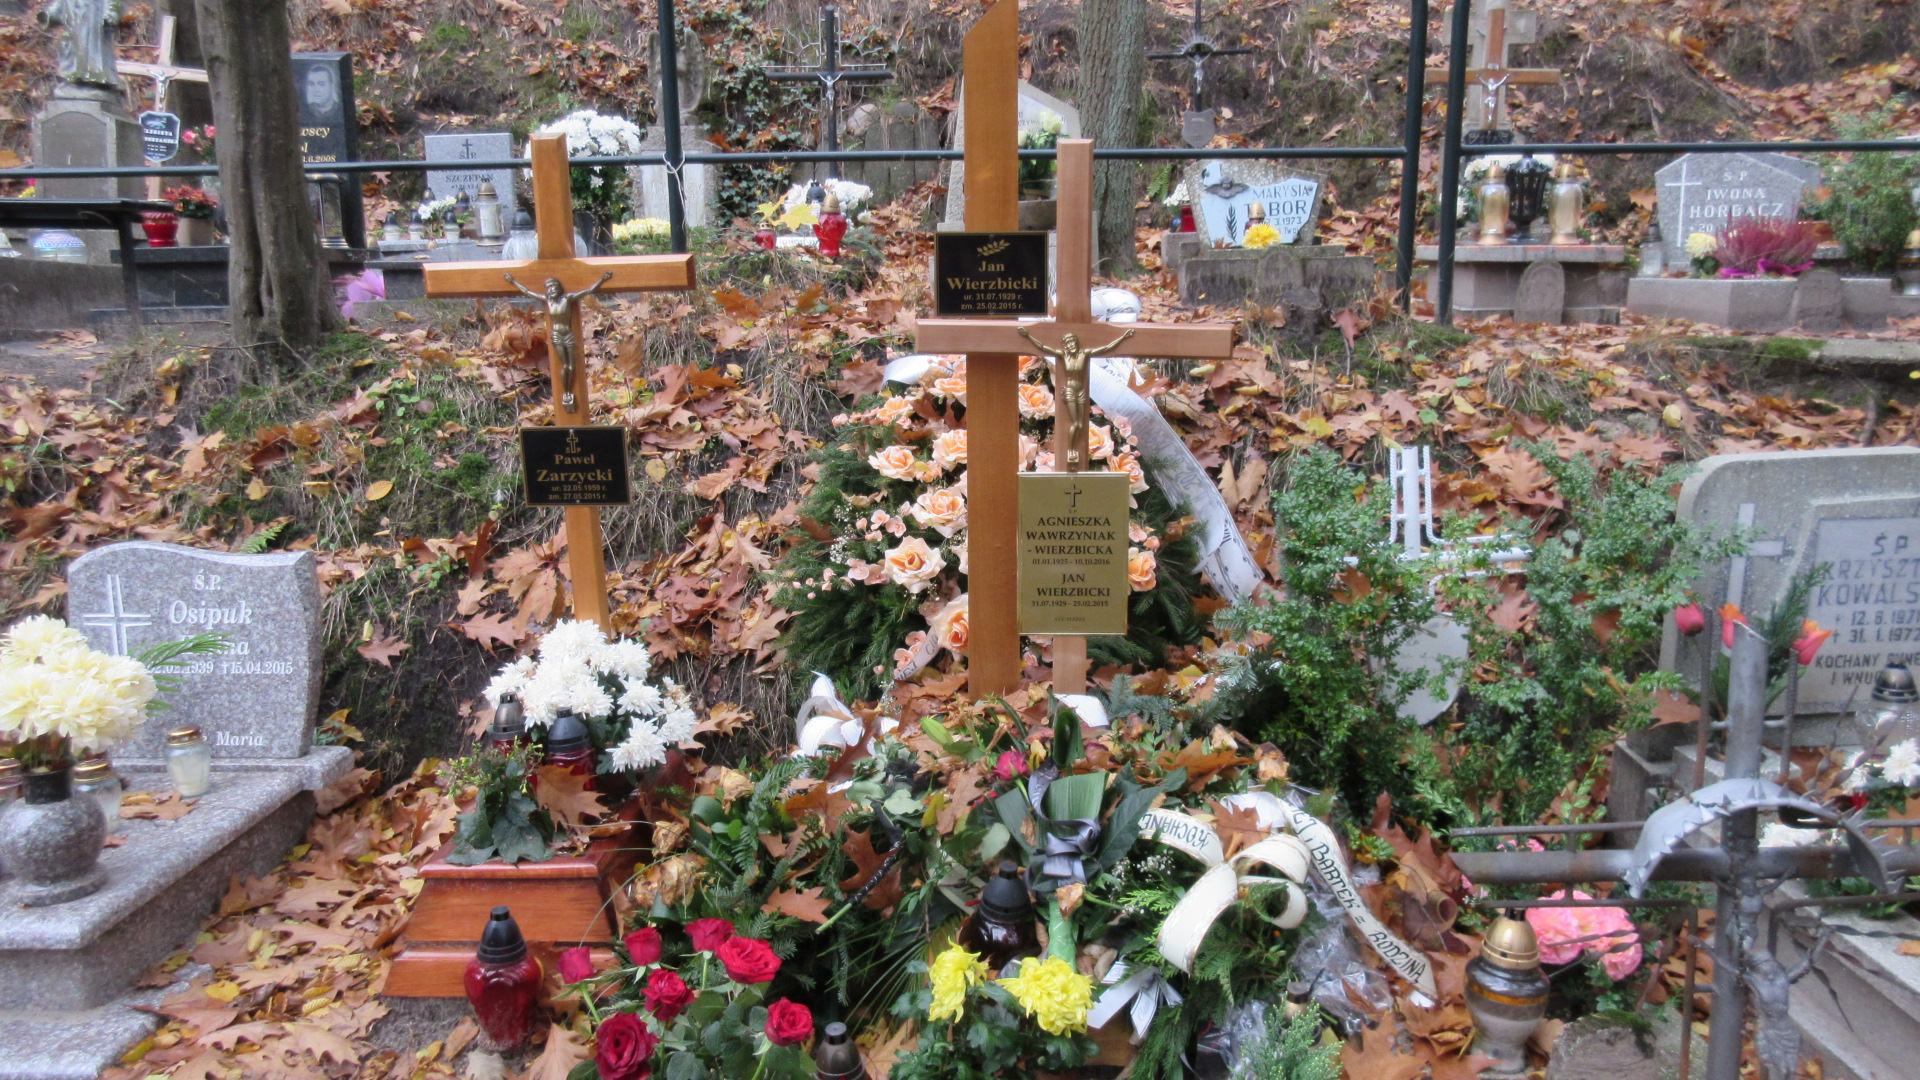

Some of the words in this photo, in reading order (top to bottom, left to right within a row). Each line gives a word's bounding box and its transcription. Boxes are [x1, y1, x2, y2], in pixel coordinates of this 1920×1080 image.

[1252, 184, 1309, 200] MARYSIA
[1706, 187, 1767, 200] IWONA
[1244, 200, 1307, 219] TBOR
[978, 260, 1005, 272] Jan
[946, 276, 1039, 290] Wierzbicki
[975, 292, 1016, 300] 31.07.1929
[976, 302, 1017, 310] 25.02.2015
[536, 468, 614, 485] Zarzycki
[1037, 517, 1111, 527] AGNIESZKA
[1026, 531, 1116, 541] WAWRZYNIAK
[1034, 545, 1113, 555] WIERZBICKA
[1871, 532, 1888, 556] Ś
[1895, 535, 1909, 554] P
[1032, 558, 1068, 566] 01.01.1925
[1075, 558, 1111, 566] 10.10.2016
[1061, 573, 1086, 584] JAN
[1037, 587, 1111, 597] WIERZBICKI
[169, 600, 253, 630] Osipuk
[1815, 652, 1881, 669] KOCHANY
[216, 731, 263, 746] Maria
[1310, 842, 1361, 910] BARTEK
